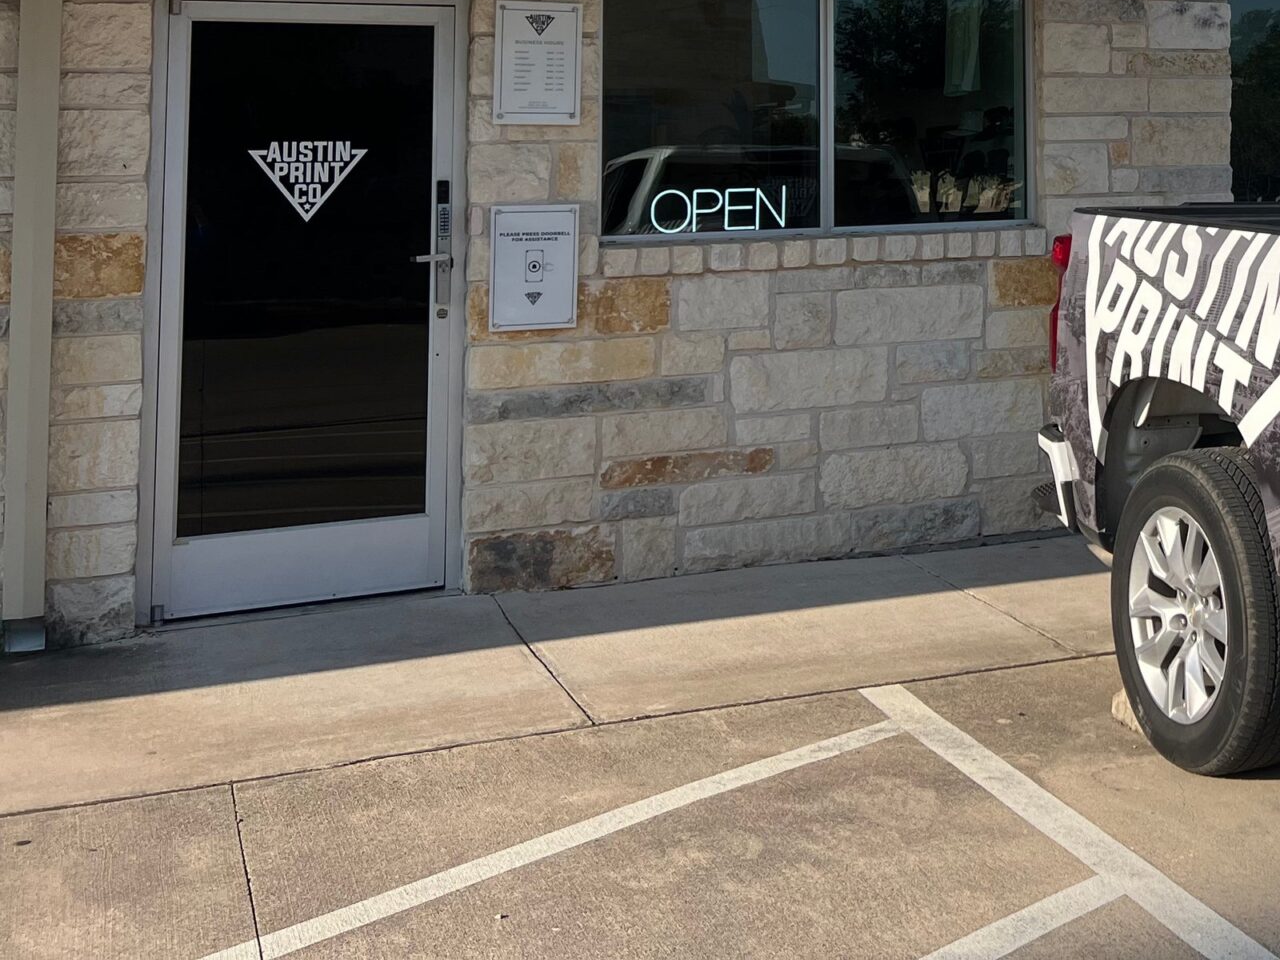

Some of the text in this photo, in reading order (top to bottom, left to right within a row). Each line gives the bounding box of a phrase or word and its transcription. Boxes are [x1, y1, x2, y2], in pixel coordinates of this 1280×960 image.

[266, 141, 351, 162] AUSTIN
[274, 162, 344, 183] PRINT
[294, 183, 322, 203] CO
[650, 184, 787, 234] OPEN
